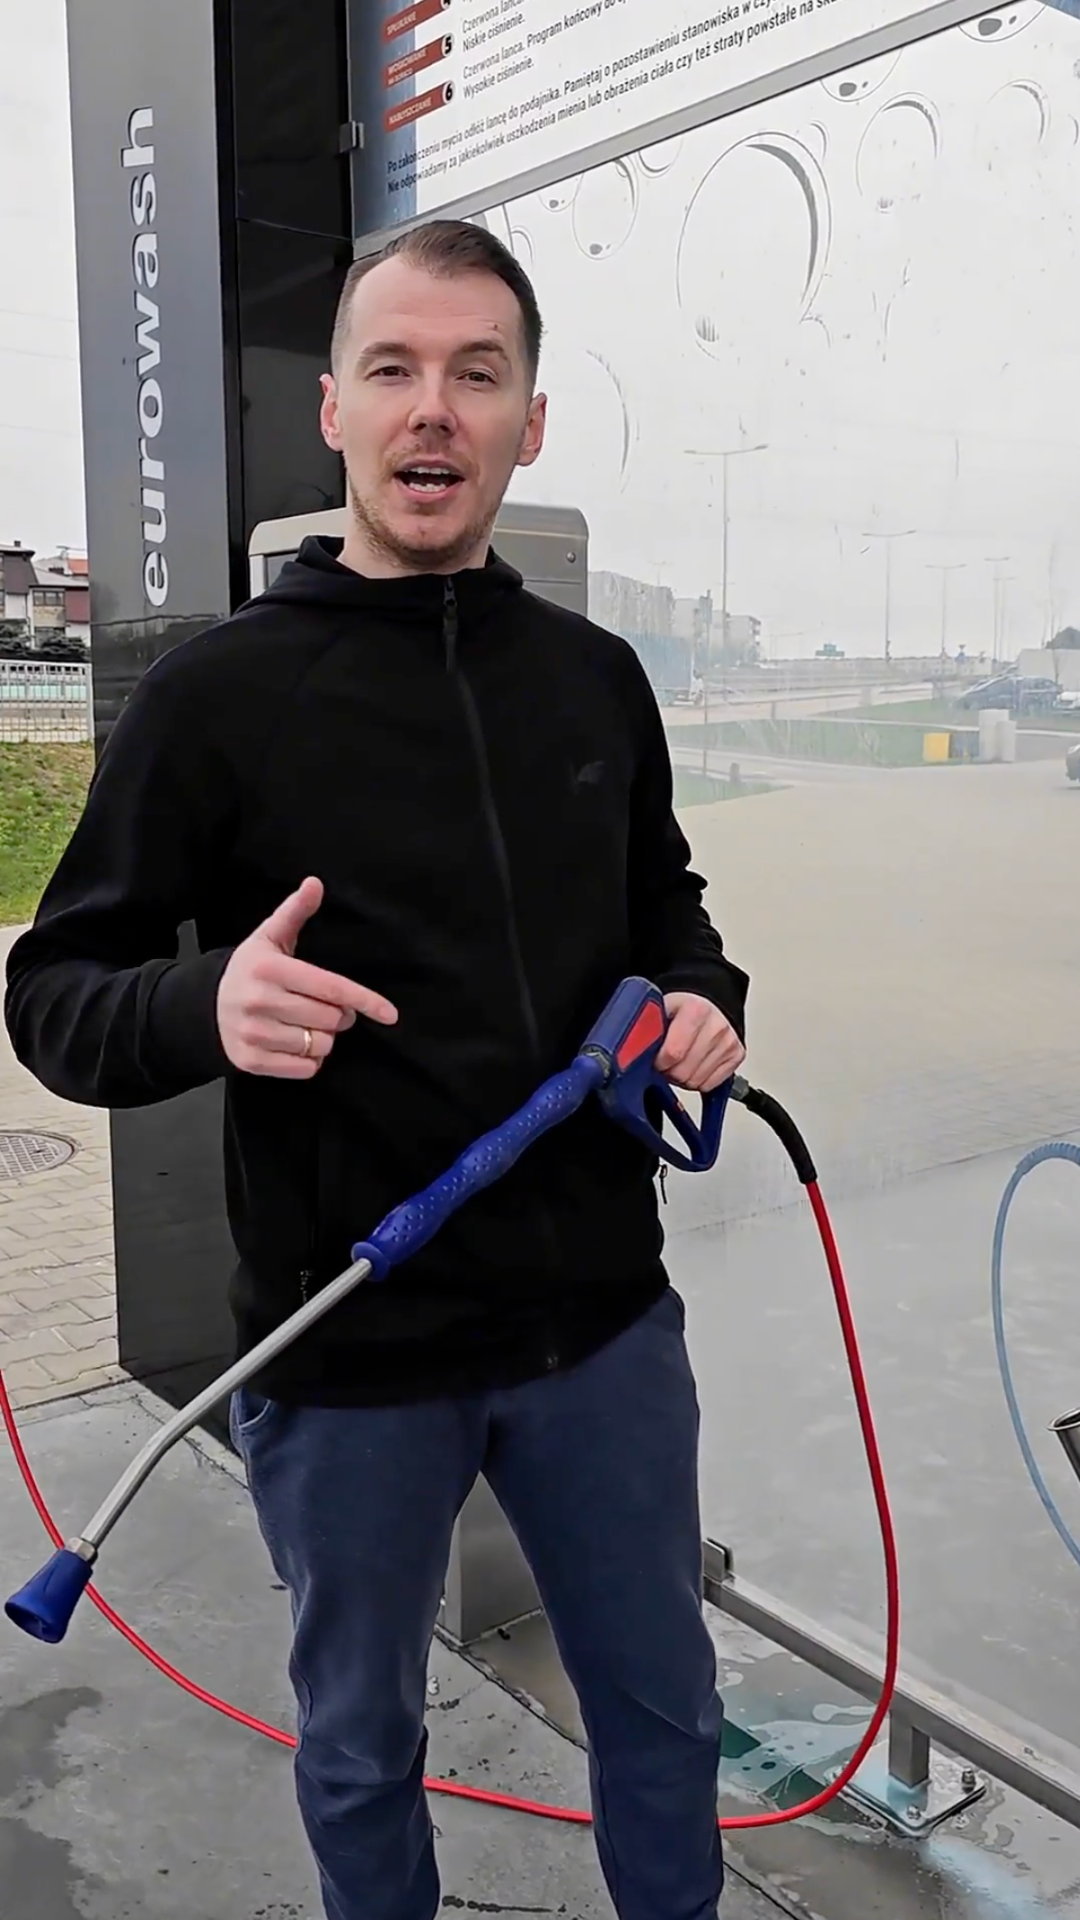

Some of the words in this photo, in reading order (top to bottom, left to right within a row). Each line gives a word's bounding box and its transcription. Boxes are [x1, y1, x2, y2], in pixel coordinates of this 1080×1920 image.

[462, 6, 499, 33] Czerwona
[463, 31, 487, 52] Niskie
[488, 12, 526, 39] ciśnienie.
[463, 52, 500, 79] Czerwona
[501, 42, 525, 60] lanca.
[527, 21, 562, 47] Program
[564, 1, 602, 29] końcowy
[444, 36, 452, 54] 5
[388, 160, 397, 174] Po
[441, 130, 463, 150] mycia
[464, 119, 485, 139] odłóż
[486, 112, 507, 130] lancę
[508, 105, 518, 120] do
[520, 88, 562, 118] podajnika.
[564, 65, 603, 95] Pamiętaj
[604, 66, 611, 76] o
[612, 32, 680, 77] pozostawieniu
[682, 5, 739, 42] stanowiska
[742, 1, 751, 15] w
[388, 180, 399, 194] Nie
[400, 161, 448, 189] odpowiadamy
[449, 156, 458, 168] za
[459, 132, 505, 167] jakiekolwiek
[506, 111, 556, 142] uszkodzenia
[558, 97, 586, 121] mienia
[588, 89, 602, 108] lub
[604, 70, 649, 101] obrażenia
[650, 60, 674, 81] ciała
[676, 51, 694, 70] czy
[695, 41, 711, 62] też
[713, 29, 745, 54] straty
[747, 5, 797, 43] powstałe
[800, 0, 813, 16] na
[445, 83, 453, 101] 6
[463, 75, 495, 99] Wysokie
[497, 56, 534, 83] ciśnienie.
[121, 105, 169, 608] eurowash
